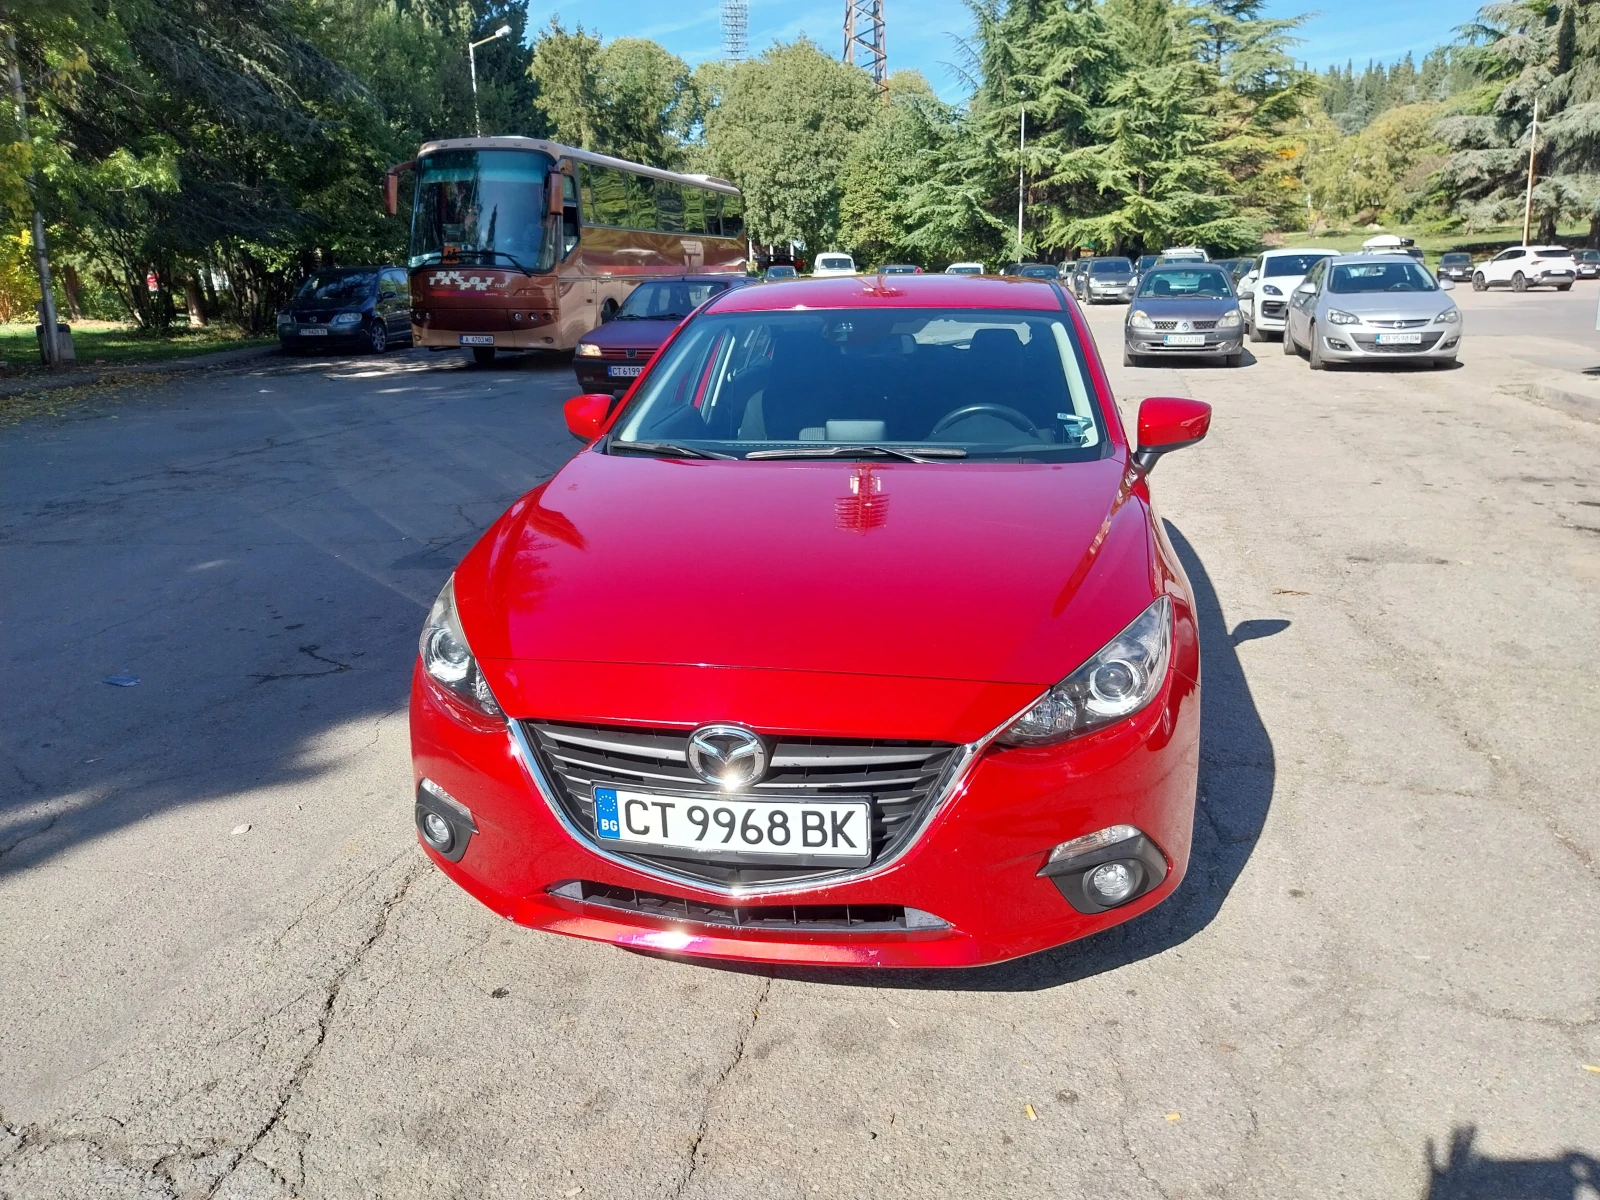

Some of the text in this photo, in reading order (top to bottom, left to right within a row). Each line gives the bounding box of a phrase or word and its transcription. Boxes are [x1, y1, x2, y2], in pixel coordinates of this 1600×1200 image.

[429, 271, 494, 290] TRANSPORT
[612, 367, 622, 376] CT
[623, 367, 640, 376] 6199
[601, 818, 619, 832] BG
[624, 798, 858, 849] CT 9968 BK
